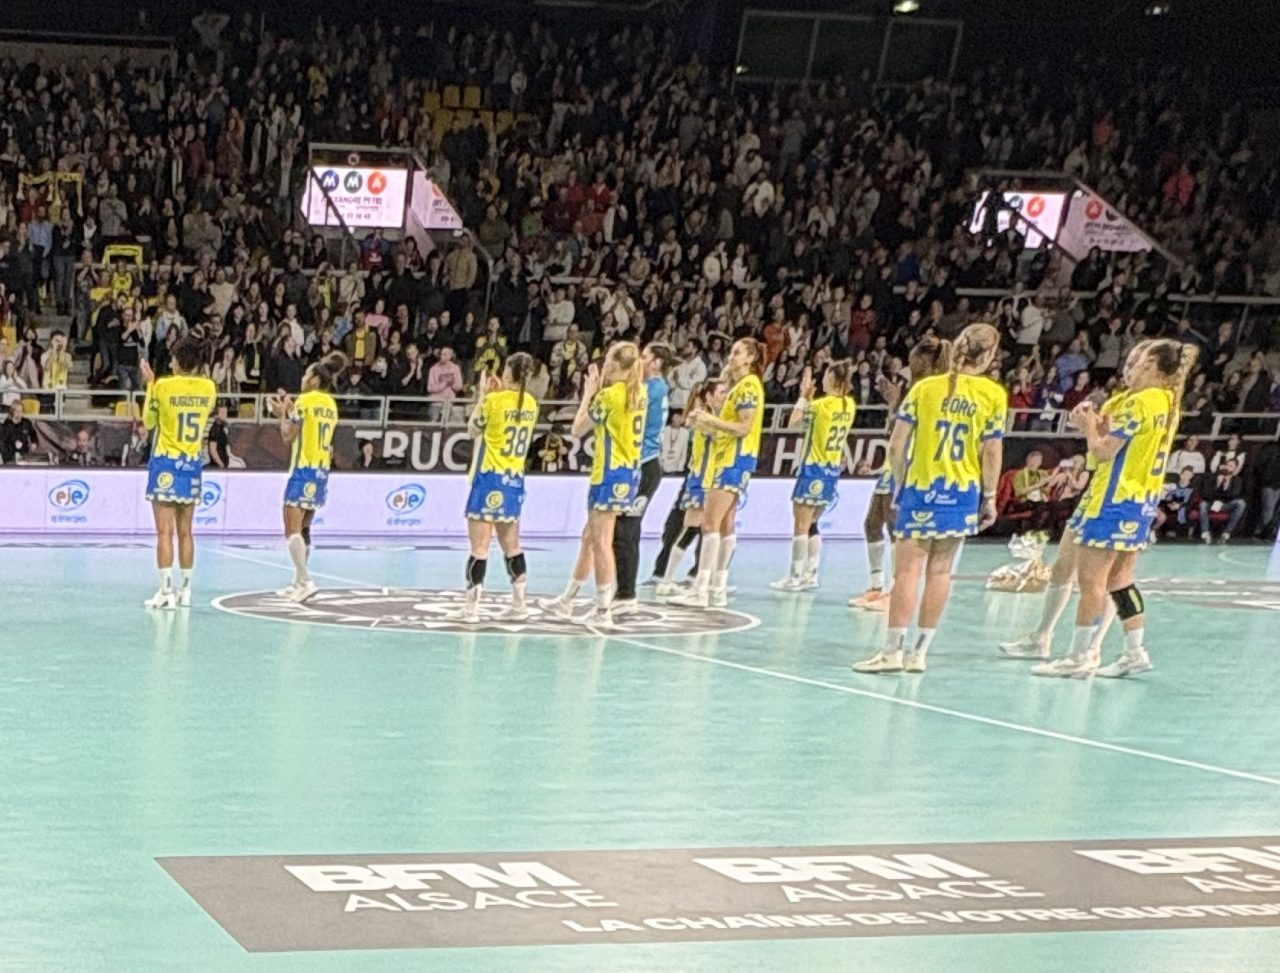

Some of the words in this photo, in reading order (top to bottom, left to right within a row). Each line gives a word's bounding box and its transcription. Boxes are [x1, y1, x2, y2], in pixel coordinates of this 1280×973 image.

[177, 412, 201, 443] 15
[825, 425, 847, 451] 22
[933, 419, 969, 462] 76
[501, 427, 529, 458] 38
[283, 861, 583, 892] BFM
[693, 853, 992, 883] BFM
[780, 880, 1046, 903] ALSACE
[1182, 874, 1280, 893] ALS
[344, 889, 619, 912] ALSACE
[561, 919, 646, 932] LA
[845, 912, 927, 925] DE
[919, 907, 1101, 924] VOTRE
